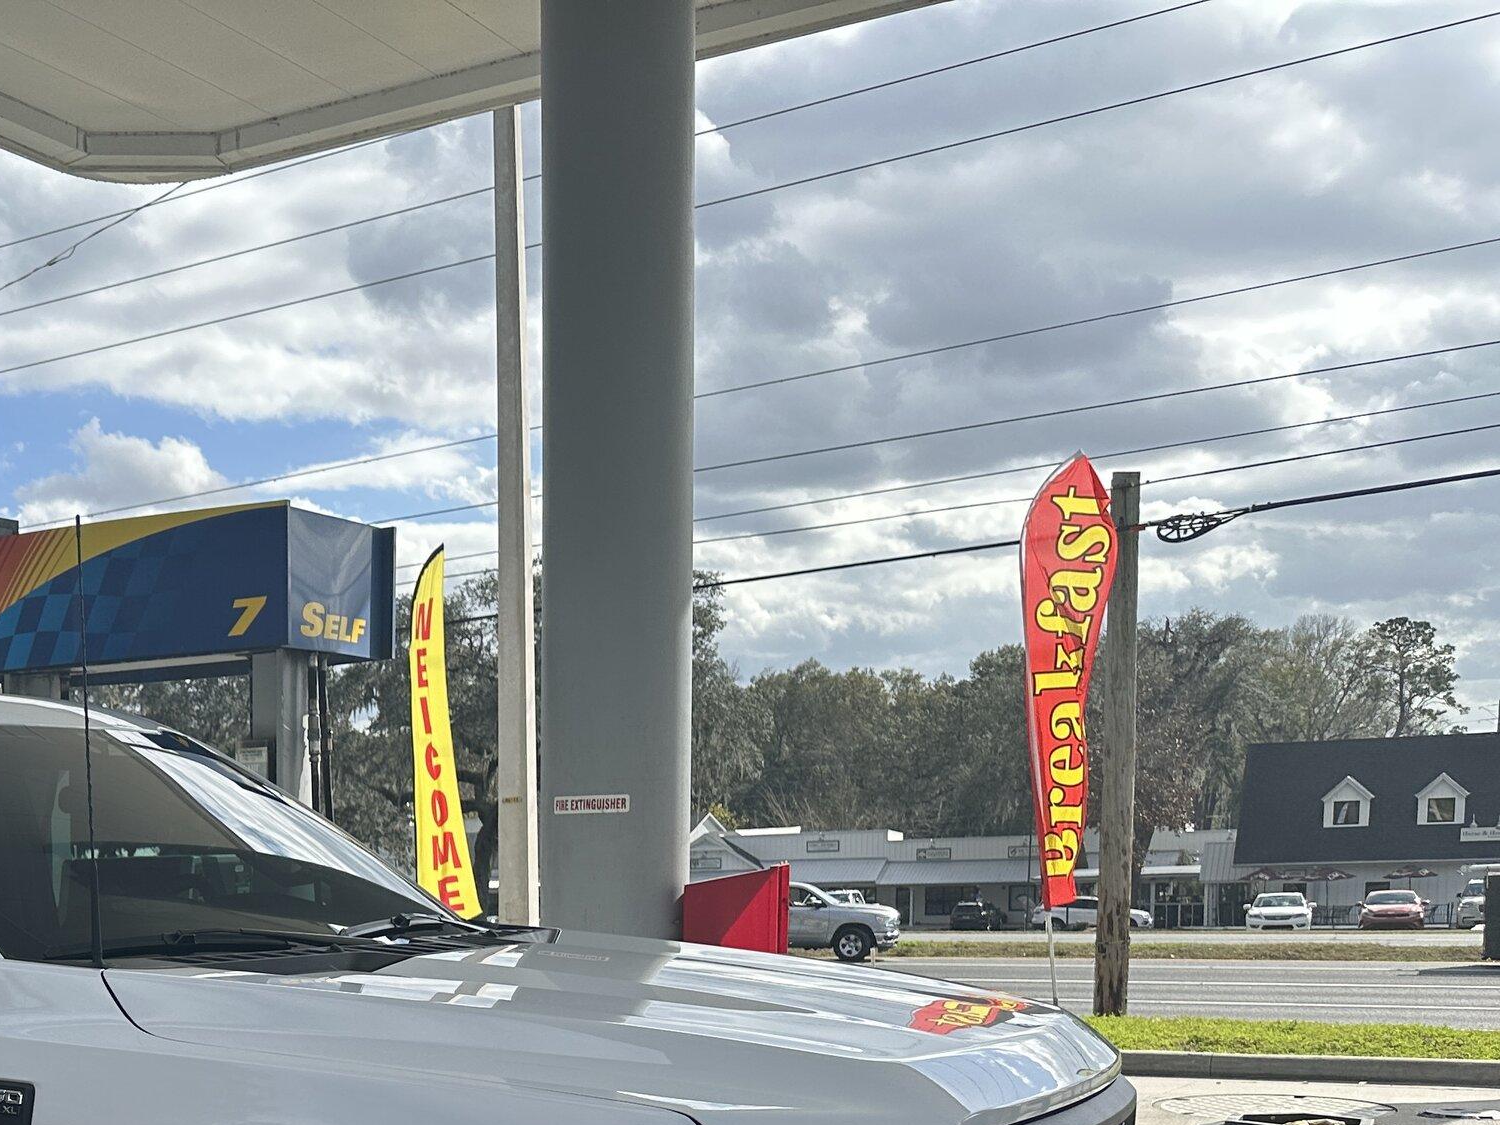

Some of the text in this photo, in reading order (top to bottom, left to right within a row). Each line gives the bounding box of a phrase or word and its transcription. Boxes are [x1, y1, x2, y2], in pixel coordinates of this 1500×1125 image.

[228, 595, 267, 637] 7
[555, 797, 627, 812] FIRE EXTINGUISHER
[2, 1105, 17, 1114] XL
